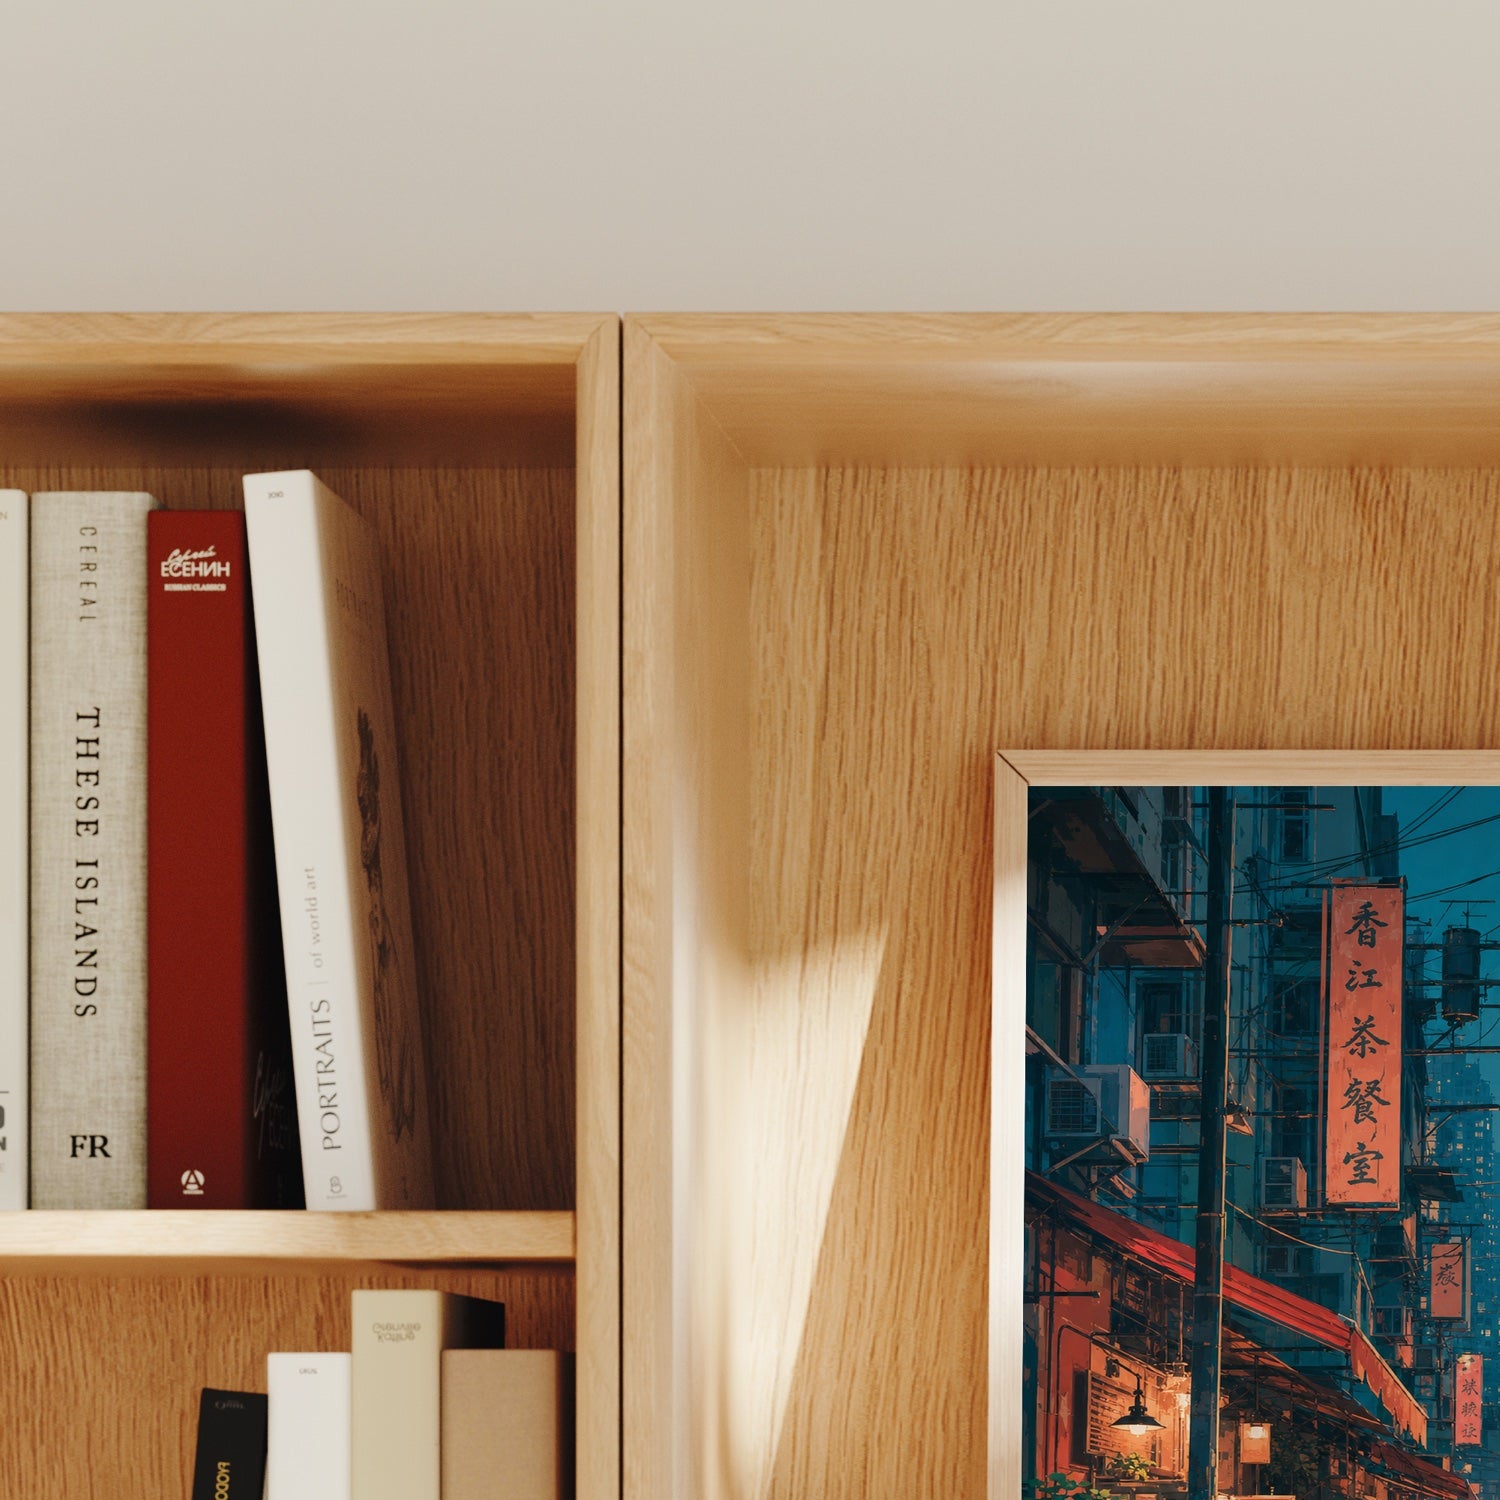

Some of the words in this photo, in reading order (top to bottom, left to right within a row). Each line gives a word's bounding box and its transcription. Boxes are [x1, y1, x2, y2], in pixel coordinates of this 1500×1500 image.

[79, 526, 98, 623] CEREAL
[160, 561, 231, 578] ЕСЕНИН
[75, 706, 101, 838] THESE
[304, 896, 322, 944] world
[305, 866, 319, 890] art
[73, 859, 100, 1018] ISLANDS
[309, 998, 343, 1151] PORTRAITS
[1340, 901, 1391, 1186] 香江茶餐室
[69, 1134, 112, 1158] FR
